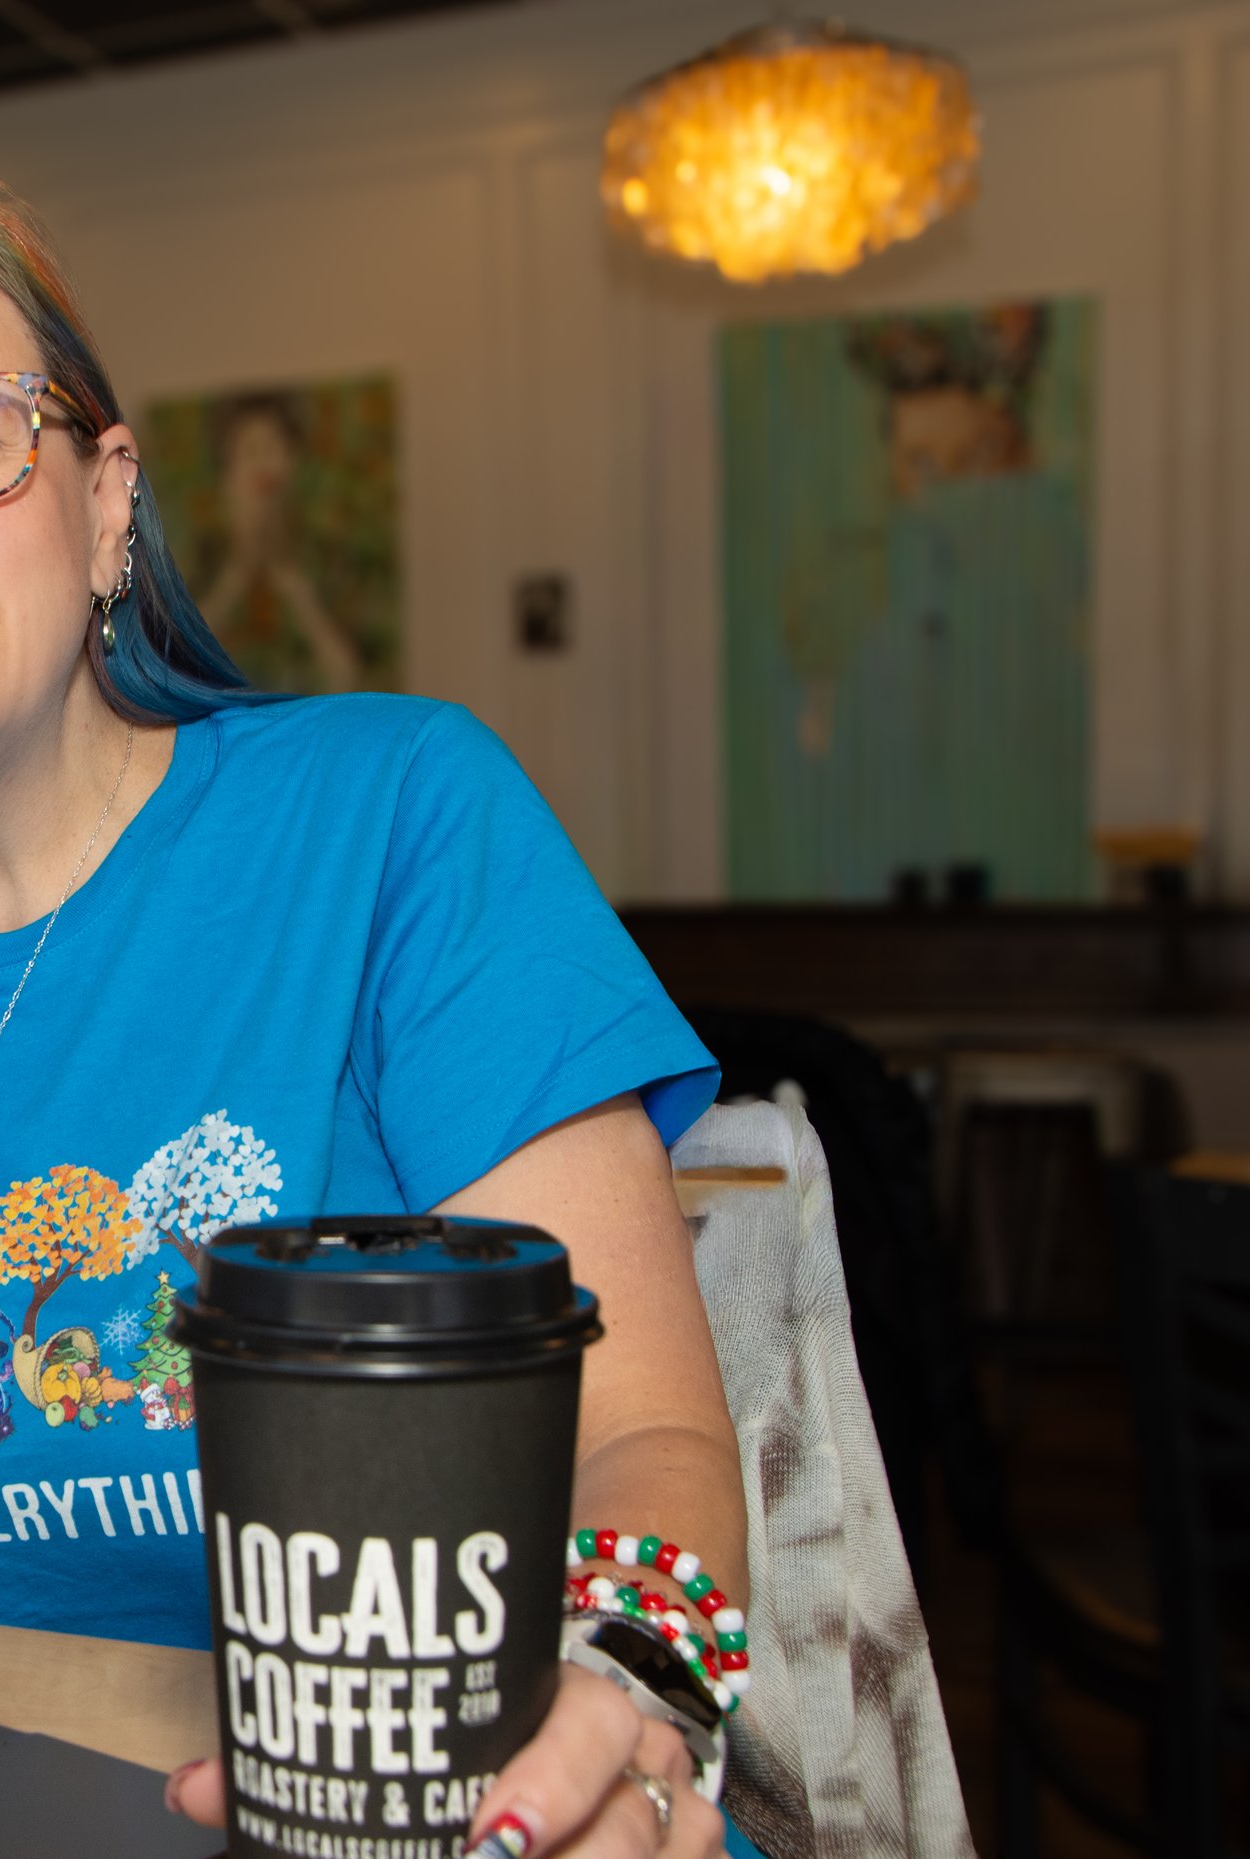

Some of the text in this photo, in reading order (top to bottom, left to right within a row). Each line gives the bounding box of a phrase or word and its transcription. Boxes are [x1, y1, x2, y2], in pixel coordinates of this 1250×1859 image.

[214, 1511, 508, 1660] LOCALS
[224, 1640, 450, 1775] COFFEE
[232, 1747, 369, 1827] ROASTERY
[382, 1780, 411, 1828] &
